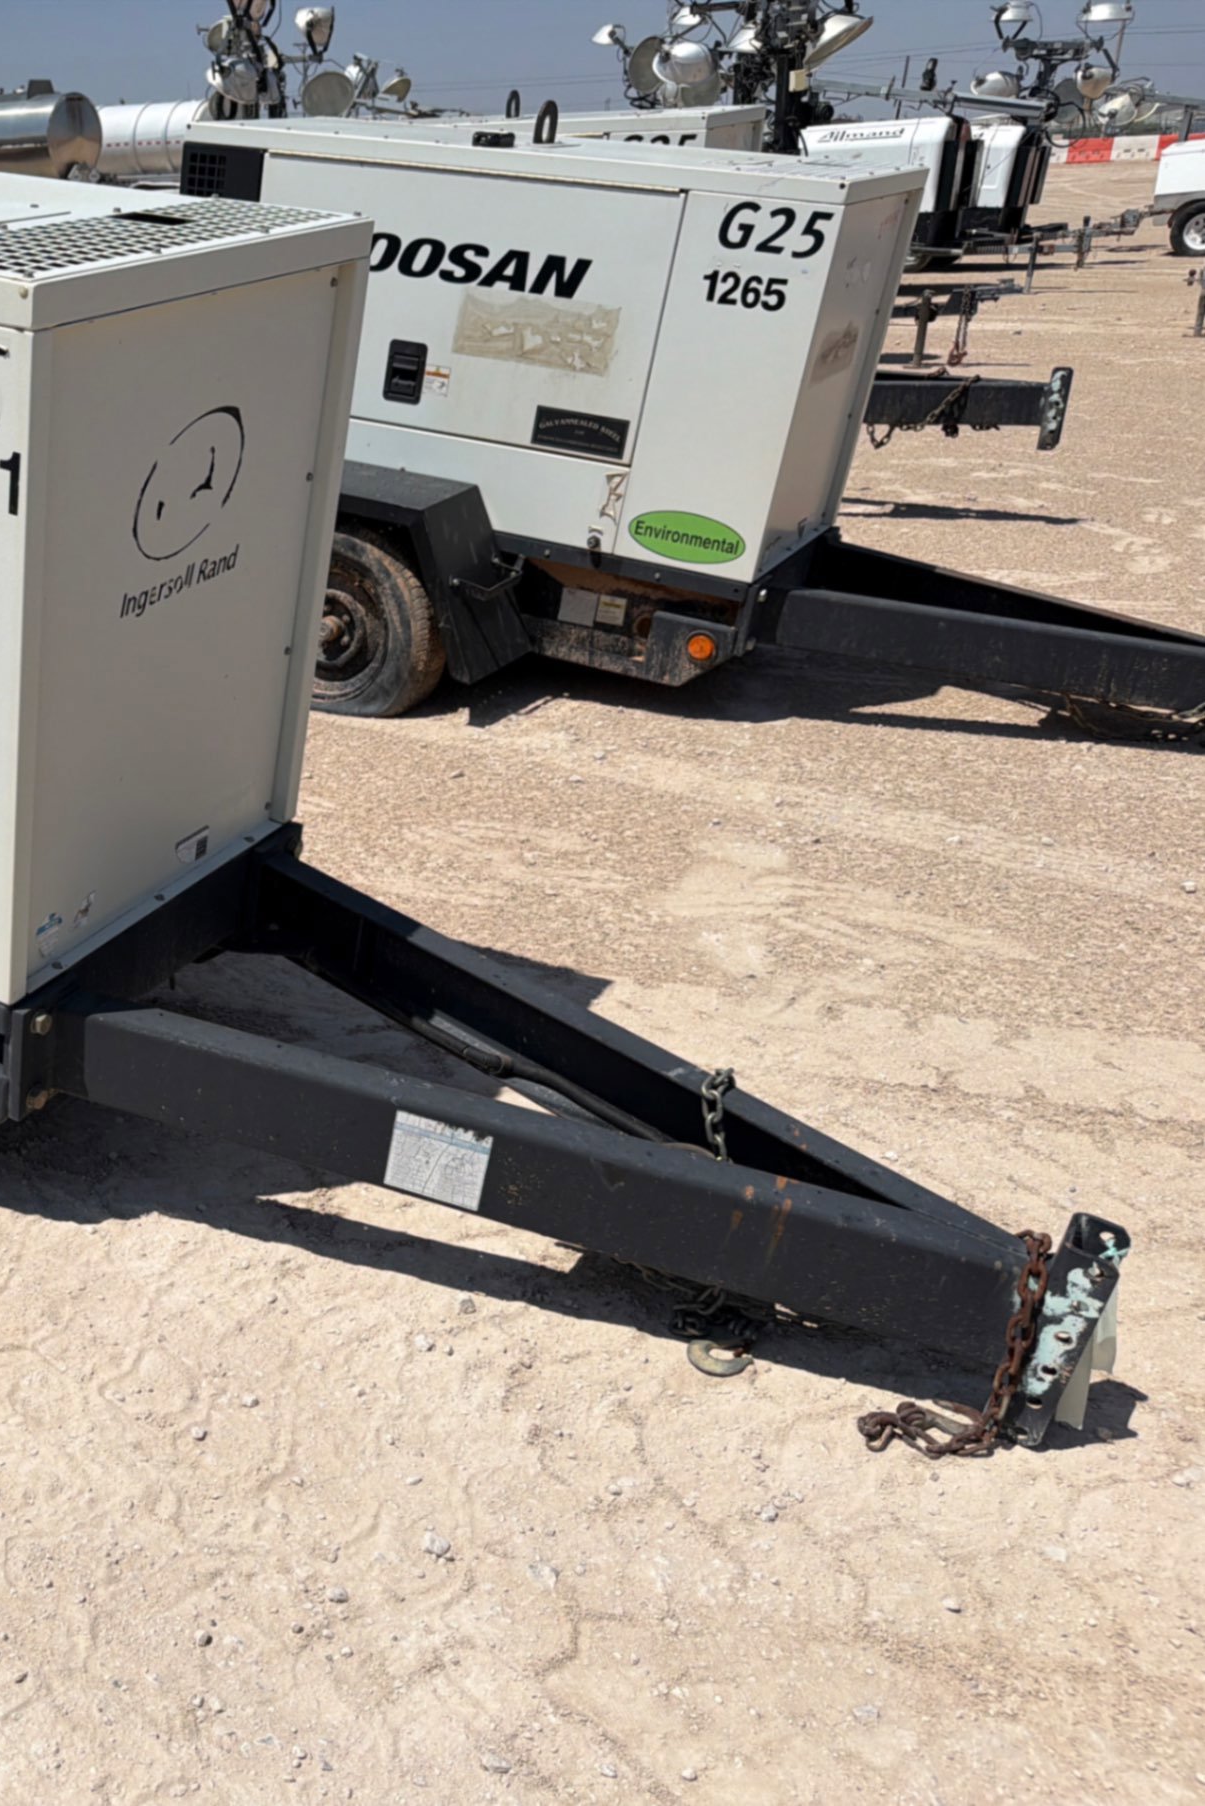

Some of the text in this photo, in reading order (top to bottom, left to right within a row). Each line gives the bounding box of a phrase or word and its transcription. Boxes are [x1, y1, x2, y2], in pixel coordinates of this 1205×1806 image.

[717, 200, 836, 260] G25
[368, 231, 594, 300] OOSAN
[702, 269, 789, 312] 1265
[633, 519, 741, 556] Environmental
[119, 543, 240, 619] Ingersoll Rand
